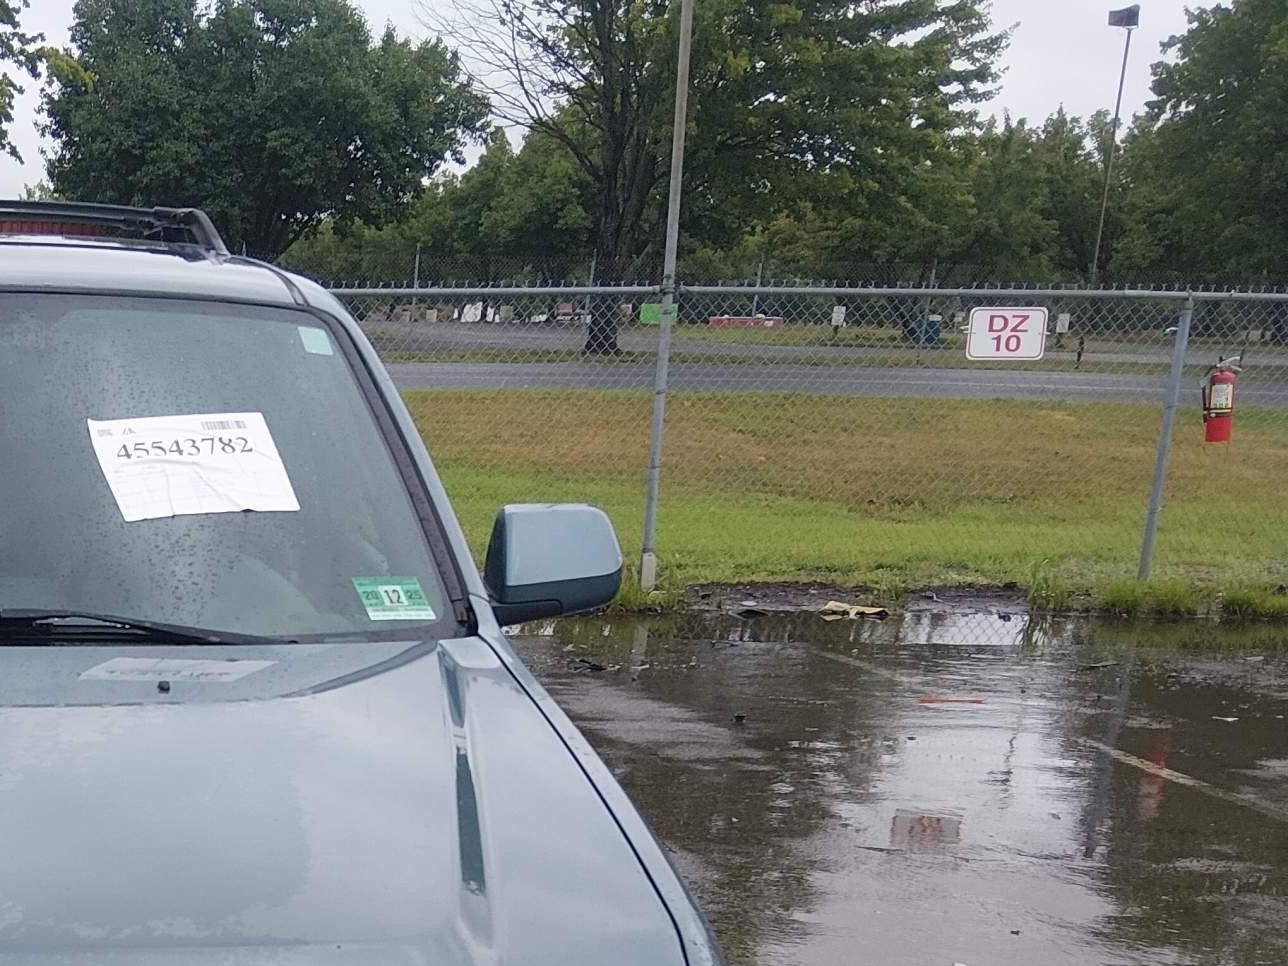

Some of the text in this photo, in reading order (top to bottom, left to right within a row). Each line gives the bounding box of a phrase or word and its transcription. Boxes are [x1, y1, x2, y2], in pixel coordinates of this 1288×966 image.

[987, 314, 1031, 333] DZ
[991, 334, 1022, 352] 10
[116, 436, 254, 460] 45543782
[383, 589, 405, 604] 12
